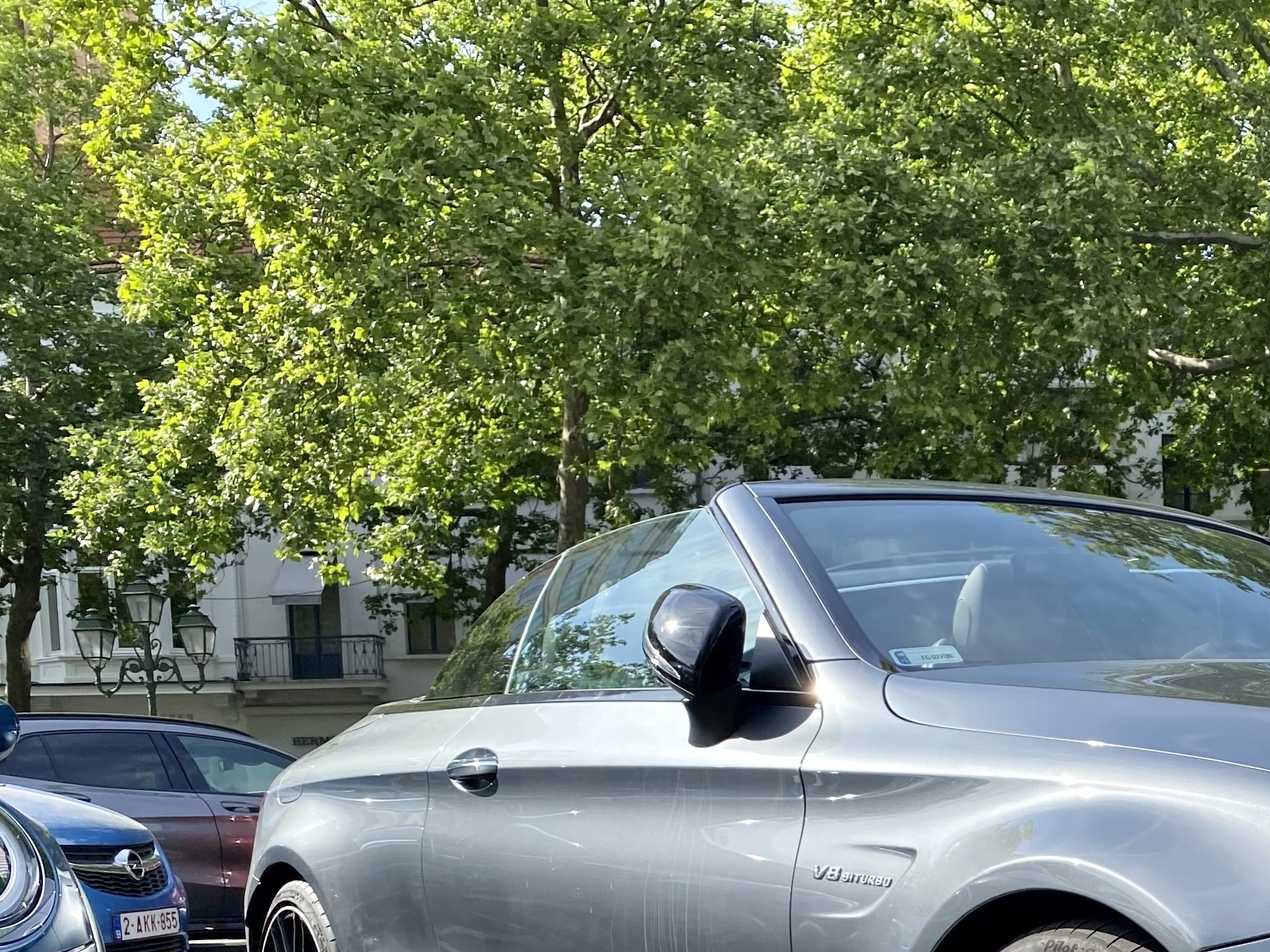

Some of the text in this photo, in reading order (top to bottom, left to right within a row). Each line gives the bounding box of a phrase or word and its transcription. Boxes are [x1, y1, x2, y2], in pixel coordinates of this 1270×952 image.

[813, 865, 893, 888] V8 BITURBO
[116, 930, 121, 939] B
[123, 911, 178, 936] 2-AKK-855
